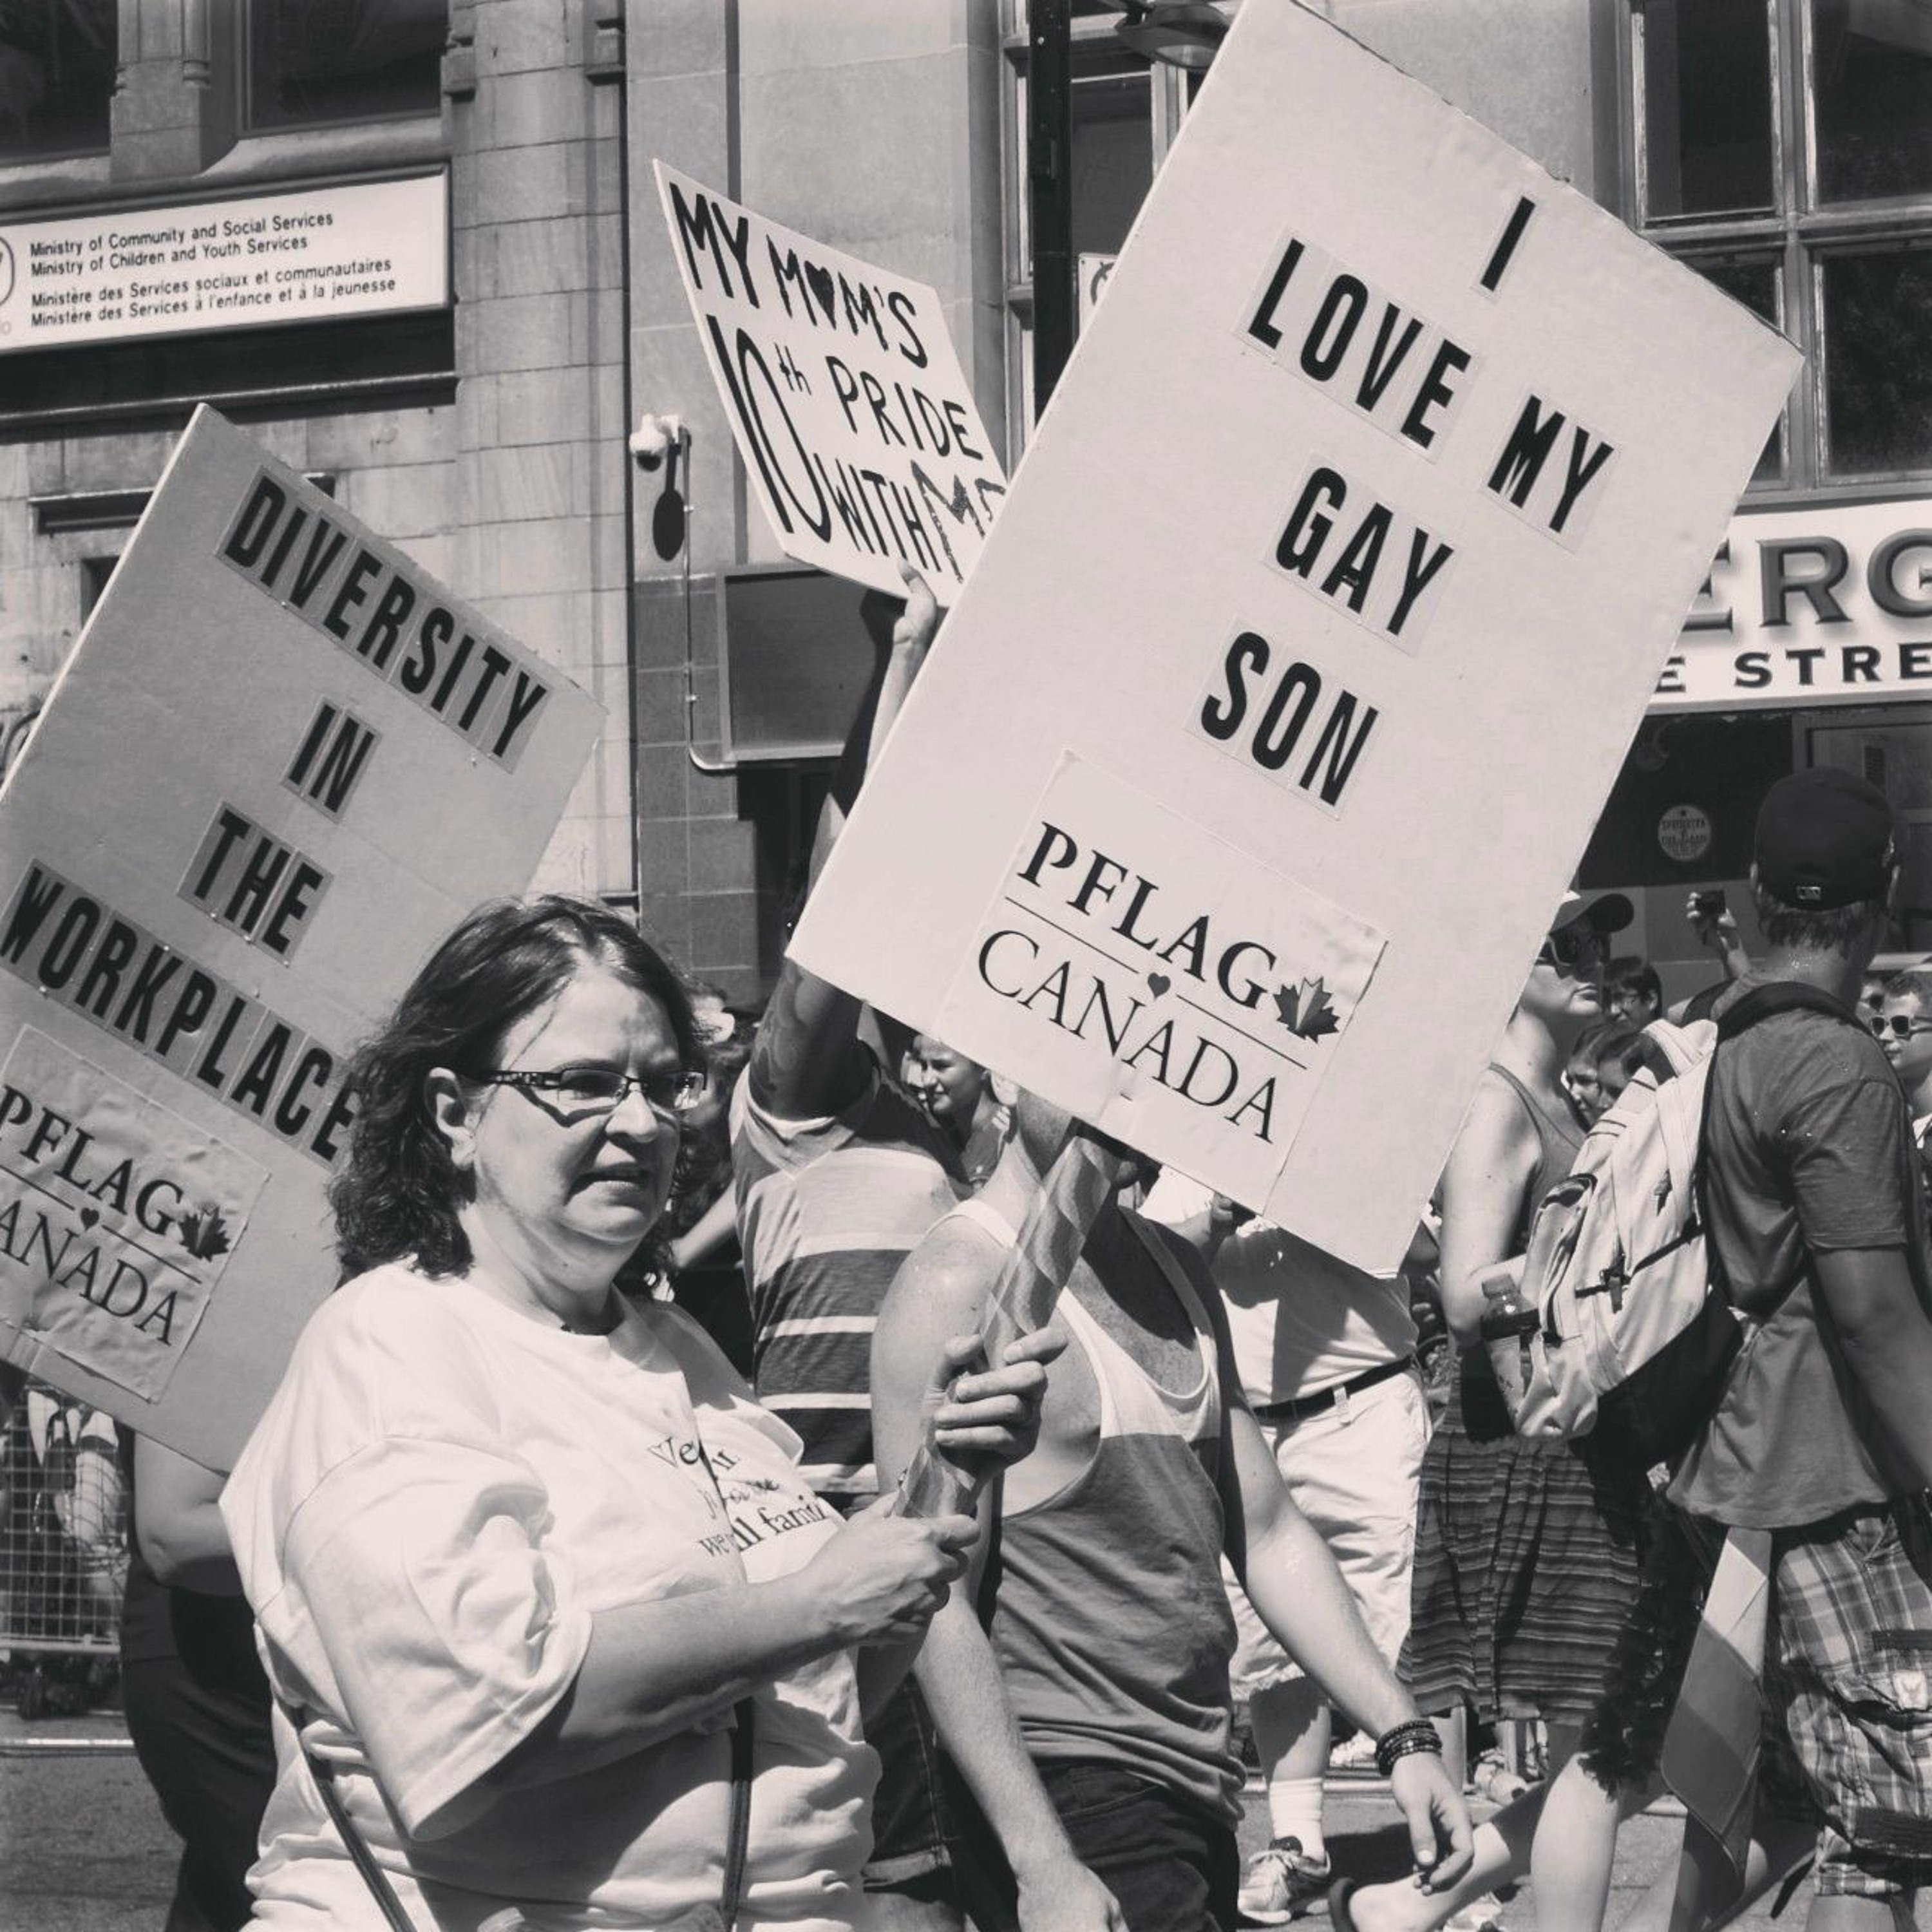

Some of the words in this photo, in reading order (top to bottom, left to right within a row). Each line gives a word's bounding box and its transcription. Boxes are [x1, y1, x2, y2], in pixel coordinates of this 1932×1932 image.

[30, 240, 82, 256] Ministry
[89, 234, 102, 251] of
[108, 229, 185, 250] Community
[192, 224, 217, 239] and
[223, 218, 267, 237] Social
[272, 213, 334, 232] Services
[31, 259, 82, 276] Ministry
[90, 254, 103, 271] of
[109, 249, 166, 269] Children
[171, 246, 196, 262] and
[203, 241, 241, 258] Youth
[247, 236, 308, 255] Services
[31, 307, 92, 327] Ministère
[98, 305, 122, 321] des
[129, 301, 189, 318] Services
[195, 294, 203, 311] à
[209, 291, 272, 309] l'enfance
[278, 288, 292, 302] et
[298, 283, 307, 299] à
[313, 284, 325, 298] la
[331, 277, 396, 300] jeunesse
[32, 287, 92, 307] Ministère
[99, 286, 124, 301] des
[129, 281, 189, 298] Services
[195, 275, 249, 291] sociaux
[255, 270, 269, 285] et
[276, 258, 392, 282] communautaires
[668, 181, 760, 309] MY
[1481, 196, 1535, 292] I
[825, 354, 983, 461] PRIDE
[1248, 239, 1472, 450] LOVE
[1487, 393, 1615, 533] MY
[813, 453, 942, 573] WITH
[1276, 467, 1454, 636] GAY
[224, 475, 547, 758] DIVERSITY
[1734, 643, 1932, 688] STRE
[288, 704, 375, 814] IN
[1200, 631, 1379, 807] SON
[193, 808, 324, 954] THE
[1016, 821, 1278, 1010] PFLAG
[0, 868, 361, 1162] WORKPLACE
[978, 930, 1277, 1144] CANADA
[0, 1084, 184, 1236] PFLAG
[0, 1199, 179, 1346] ANADA
